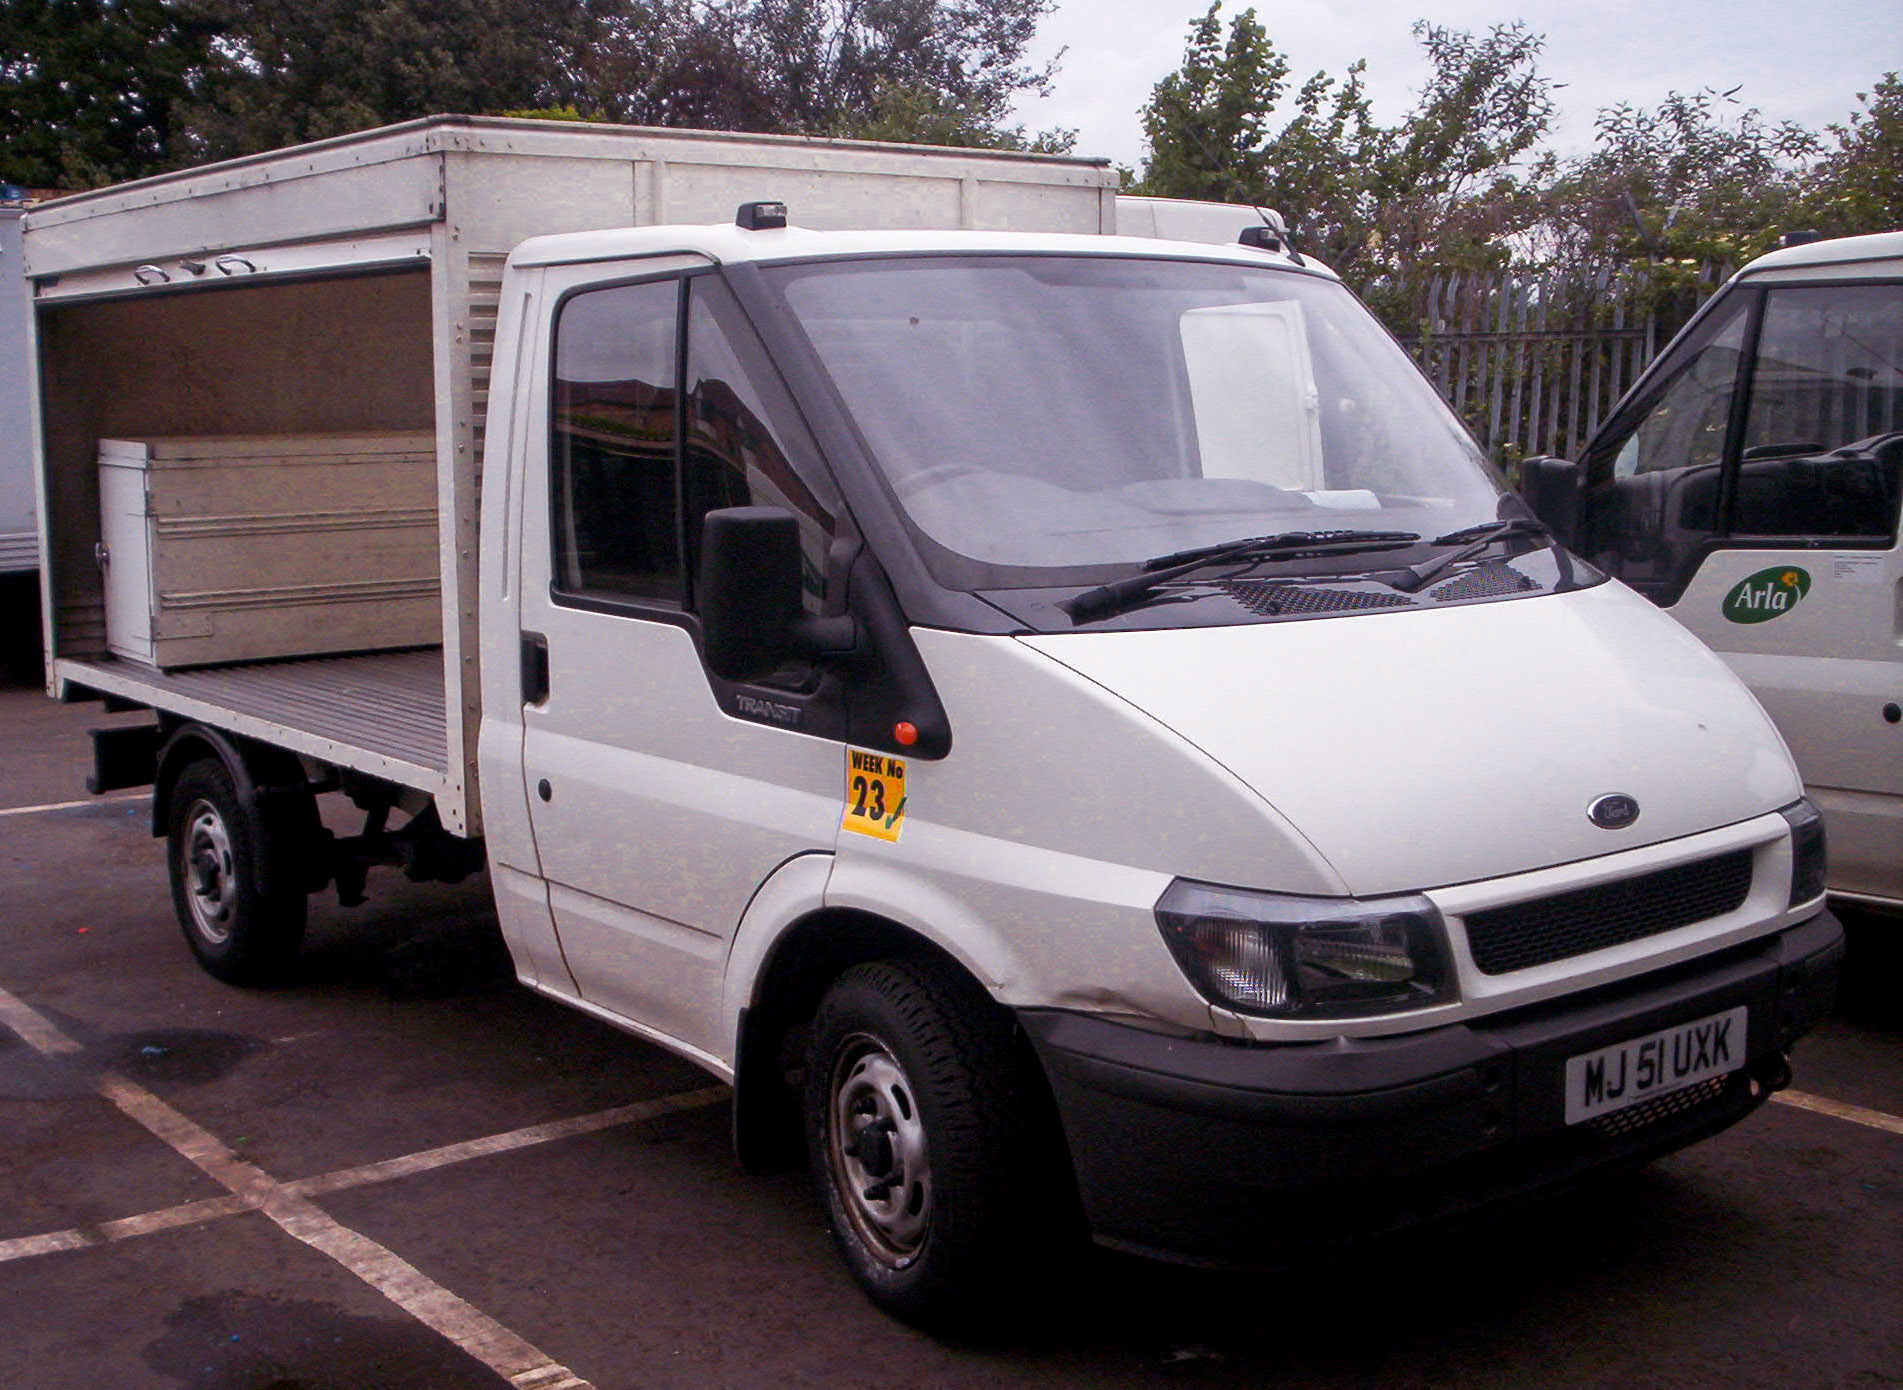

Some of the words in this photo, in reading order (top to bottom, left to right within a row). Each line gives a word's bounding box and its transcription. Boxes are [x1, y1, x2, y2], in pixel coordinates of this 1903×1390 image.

[1734, 582, 1788, 609] Arla
[736, 695, 801, 724] TRANSIT
[852, 751, 883, 774] WEEK
[886, 758, 903, 779] No
[851, 776, 884, 820] 23
[1674, 1017, 1731, 1078] UXK
